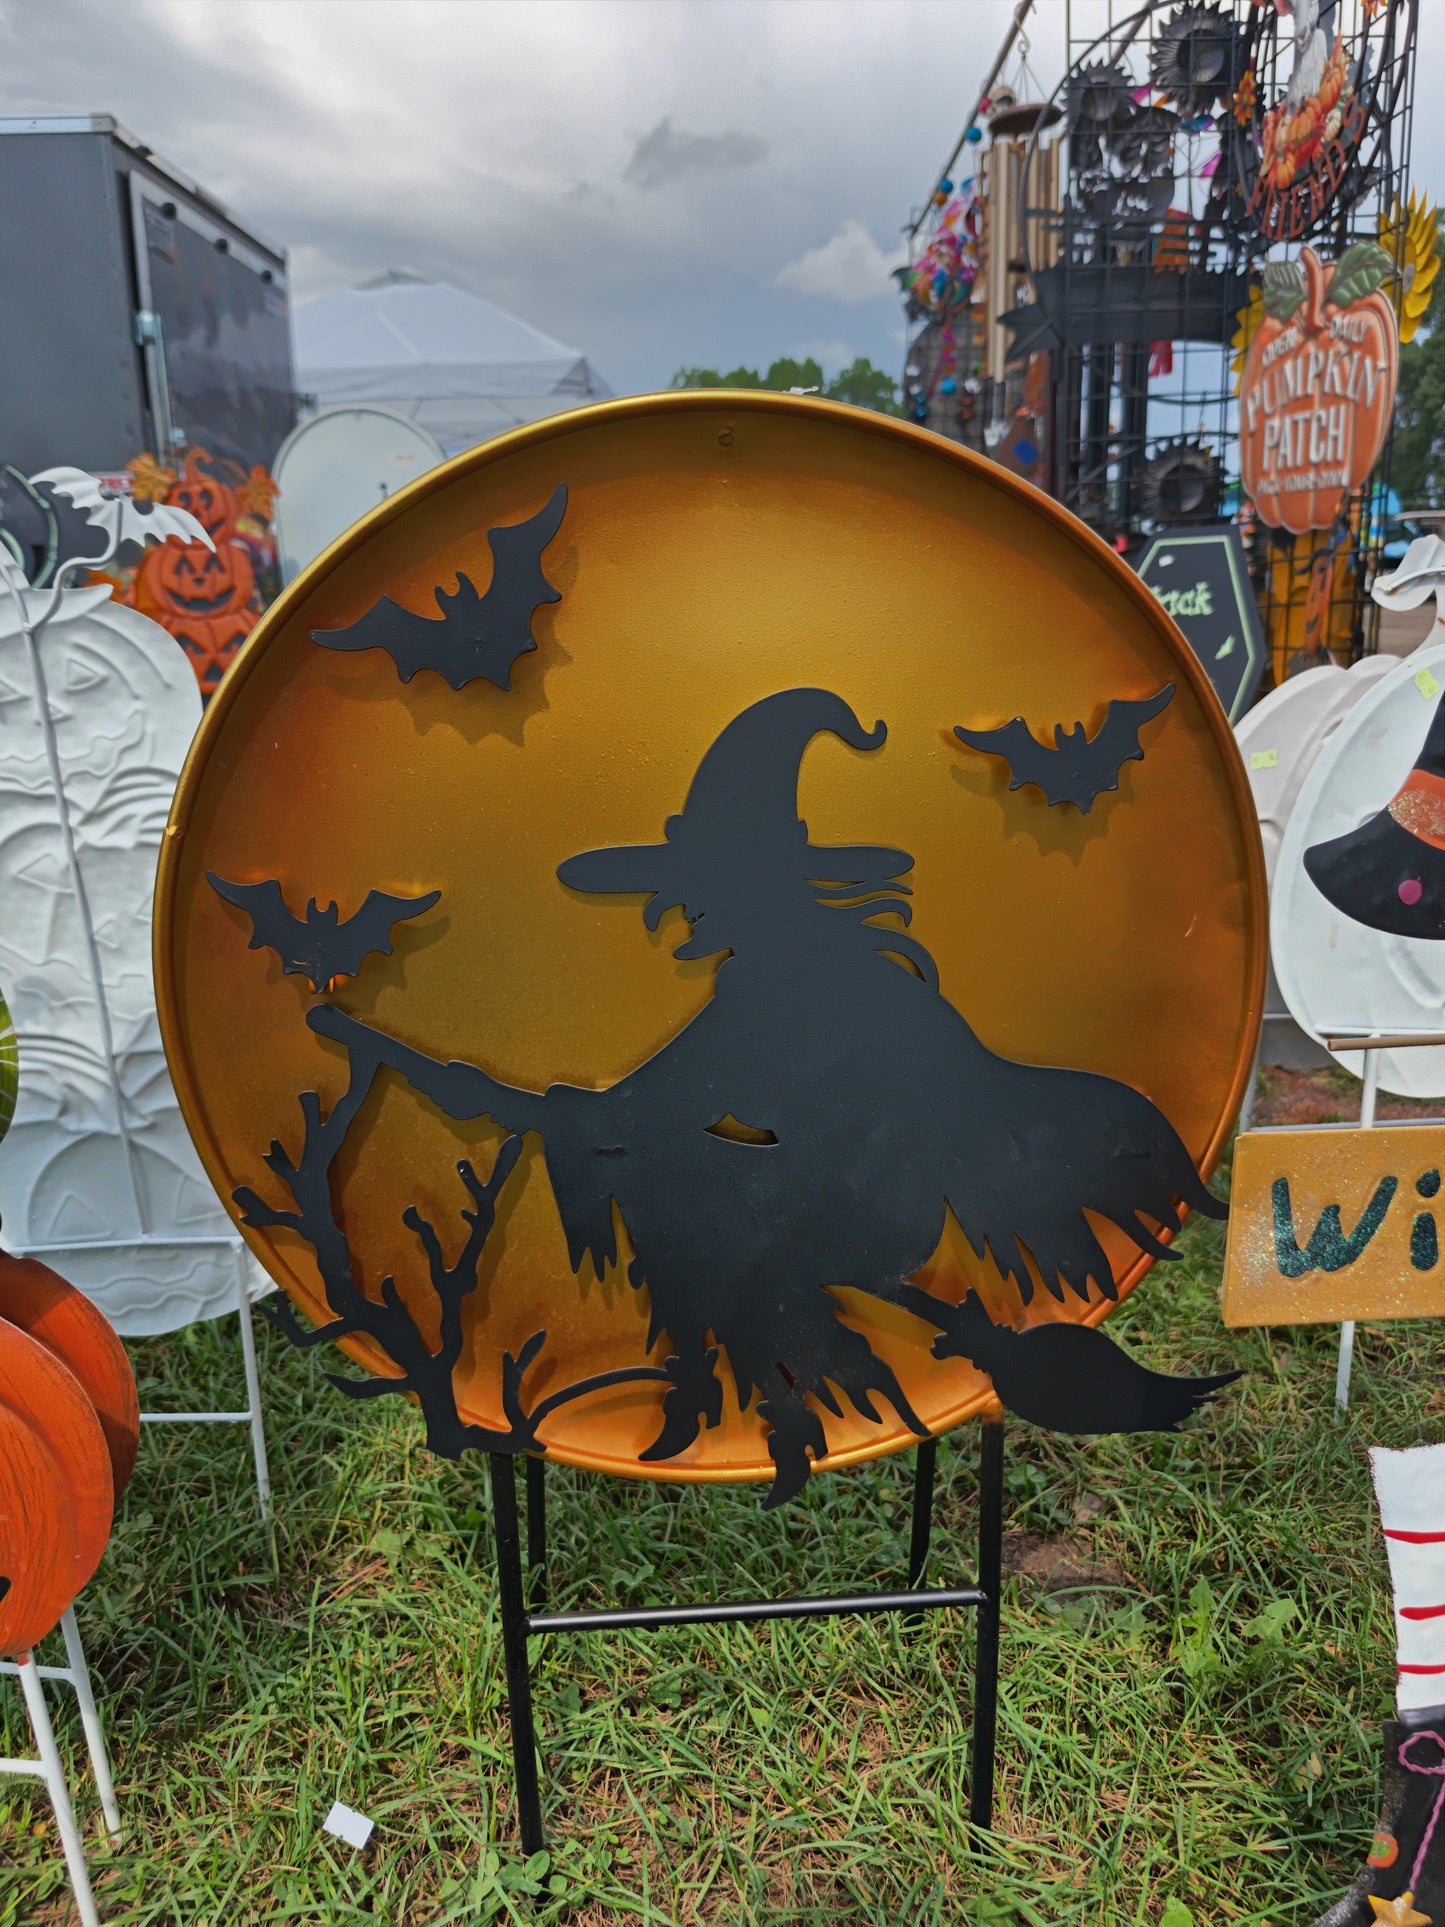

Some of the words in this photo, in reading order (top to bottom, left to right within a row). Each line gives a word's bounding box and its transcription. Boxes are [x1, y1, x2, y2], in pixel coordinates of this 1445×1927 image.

[1246, 95, 1366, 242] FRIENDS
[1262, 327, 1298, 367] OPEN
[1328, 315, 1371, 343] DAILY
[1246, 348, 1387, 432] PUMPKIN
[1262, 404, 1346, 472] PATCH
